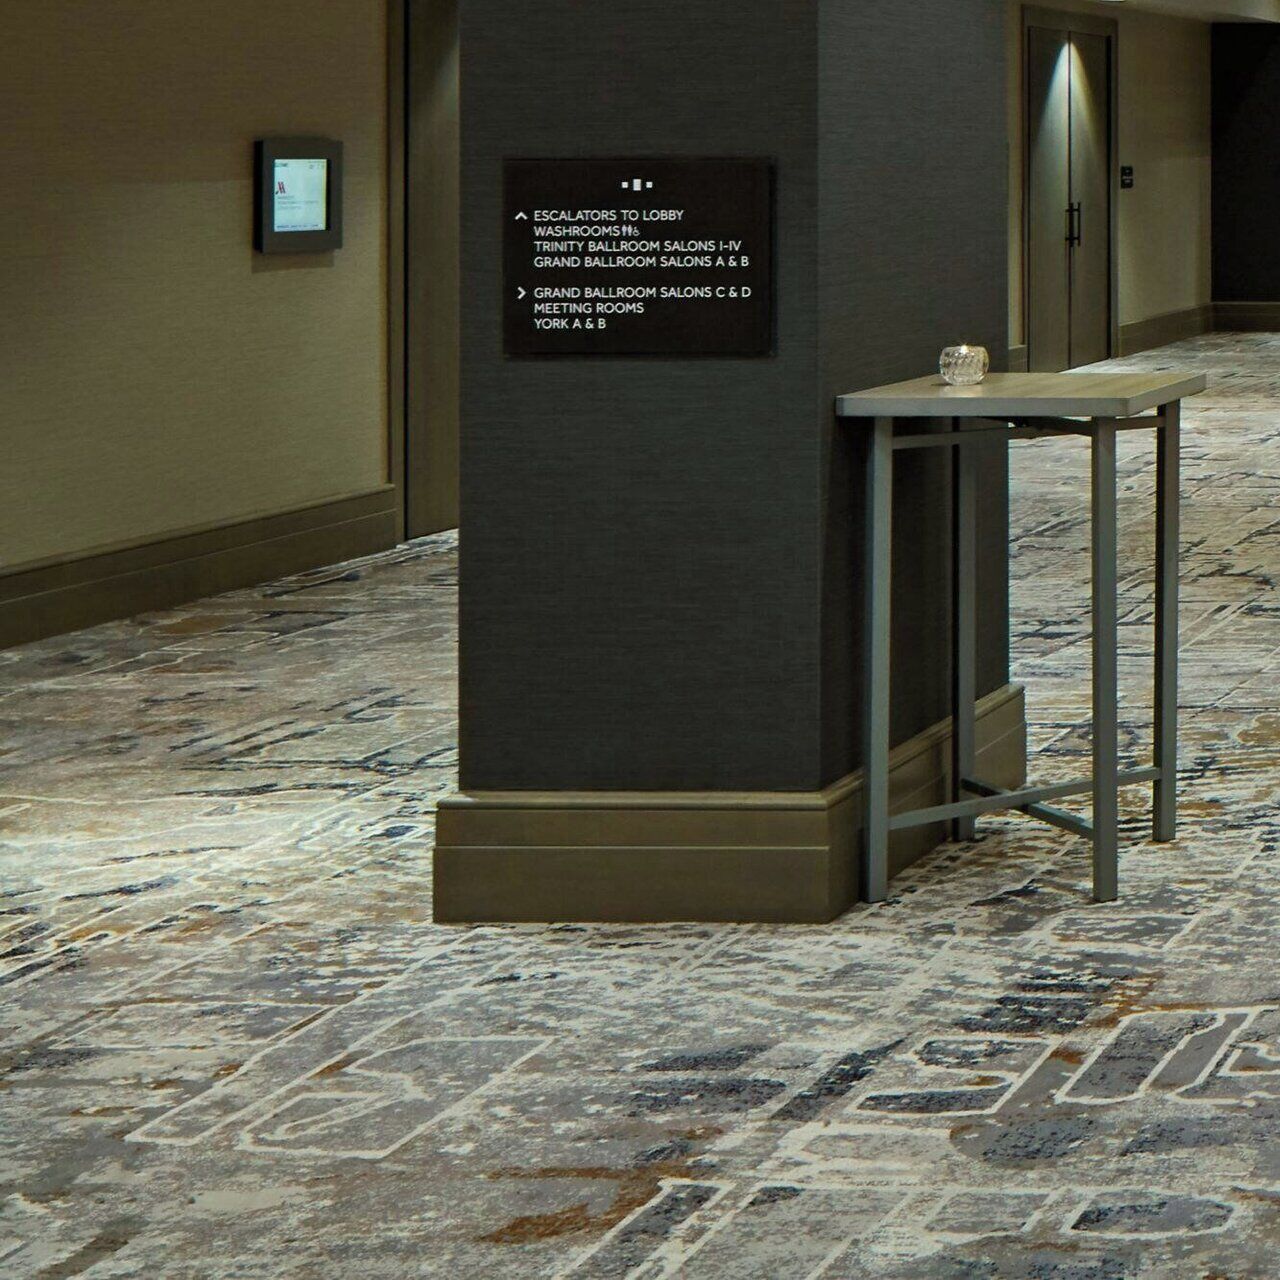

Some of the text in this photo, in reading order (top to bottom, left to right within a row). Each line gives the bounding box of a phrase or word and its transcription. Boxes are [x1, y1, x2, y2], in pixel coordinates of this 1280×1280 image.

[534, 210, 683, 221] ESCALATORS TO LOBBY
[534, 226, 620, 236] WASHROOMS
[534, 241, 741, 251] TRINITY BALLROOM SALONS I-IV
[534, 256, 749, 267] GRAND BALLROOM SALONS A & B
[534, 287, 751, 298] GRAND BALLROOM SALONS C & D
[534, 302, 644, 313] MEETING ROOMS
[534, 318, 606, 329] YORK A & B
